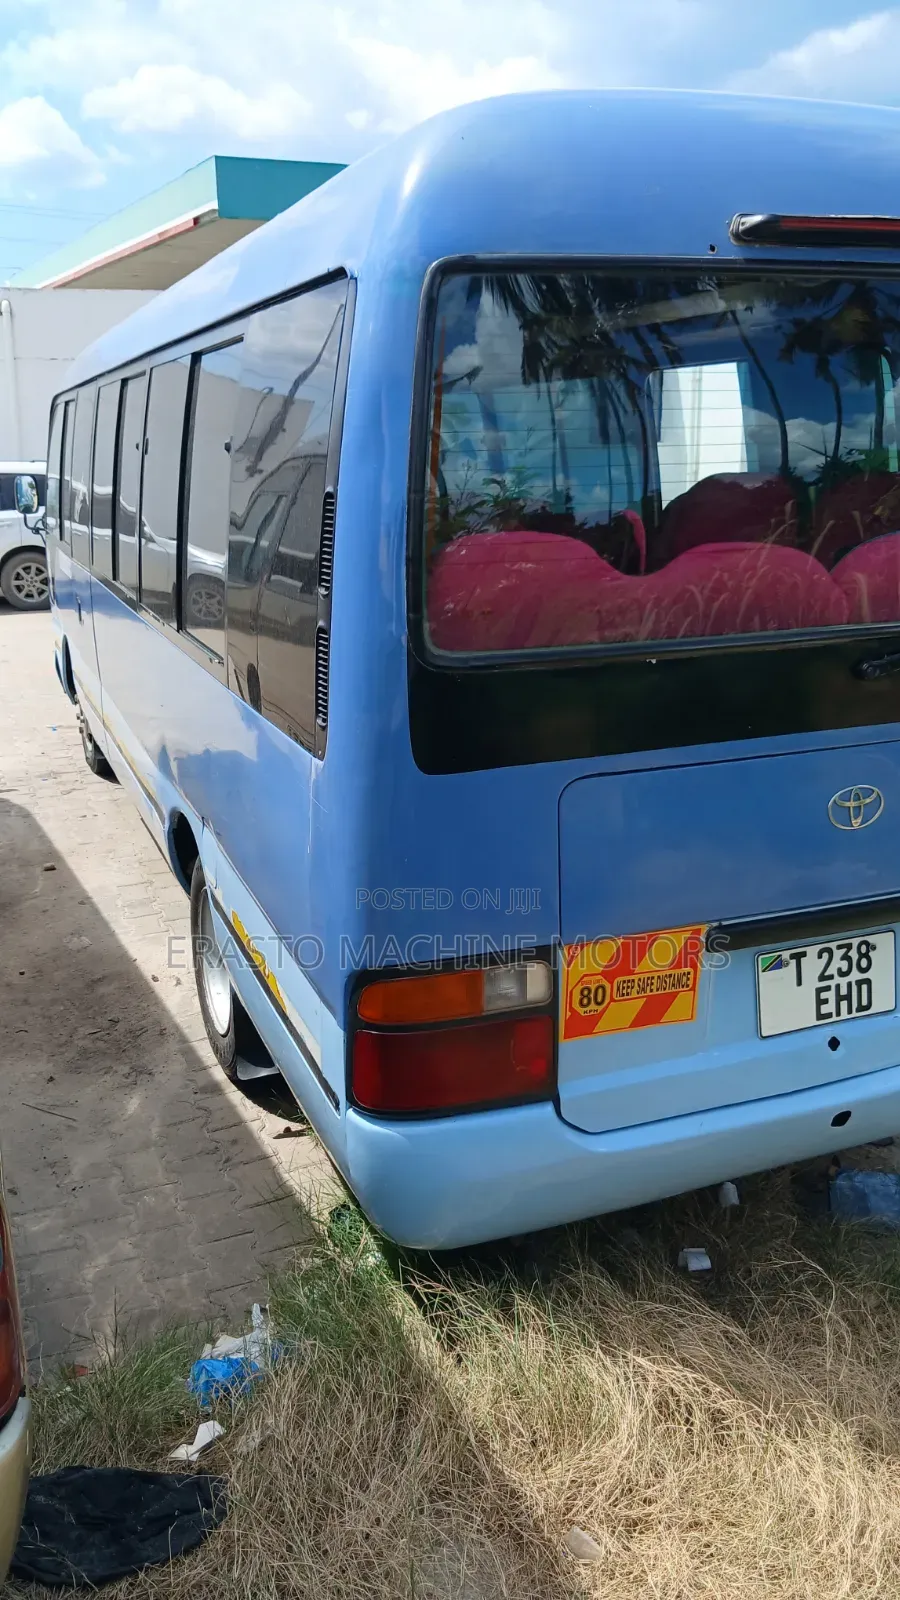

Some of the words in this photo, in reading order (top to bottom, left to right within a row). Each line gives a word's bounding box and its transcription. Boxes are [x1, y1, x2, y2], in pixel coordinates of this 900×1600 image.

[789, 950, 807, 987] T
[817, 940, 872, 982] 238
[578, 984, 606, 1008] 80
[616, 980, 634, 998] KEEP
[637, 976, 654, 995] SAFE
[656, 972, 691, 991] DISTANCE
[815, 977, 872, 1021] EHD
